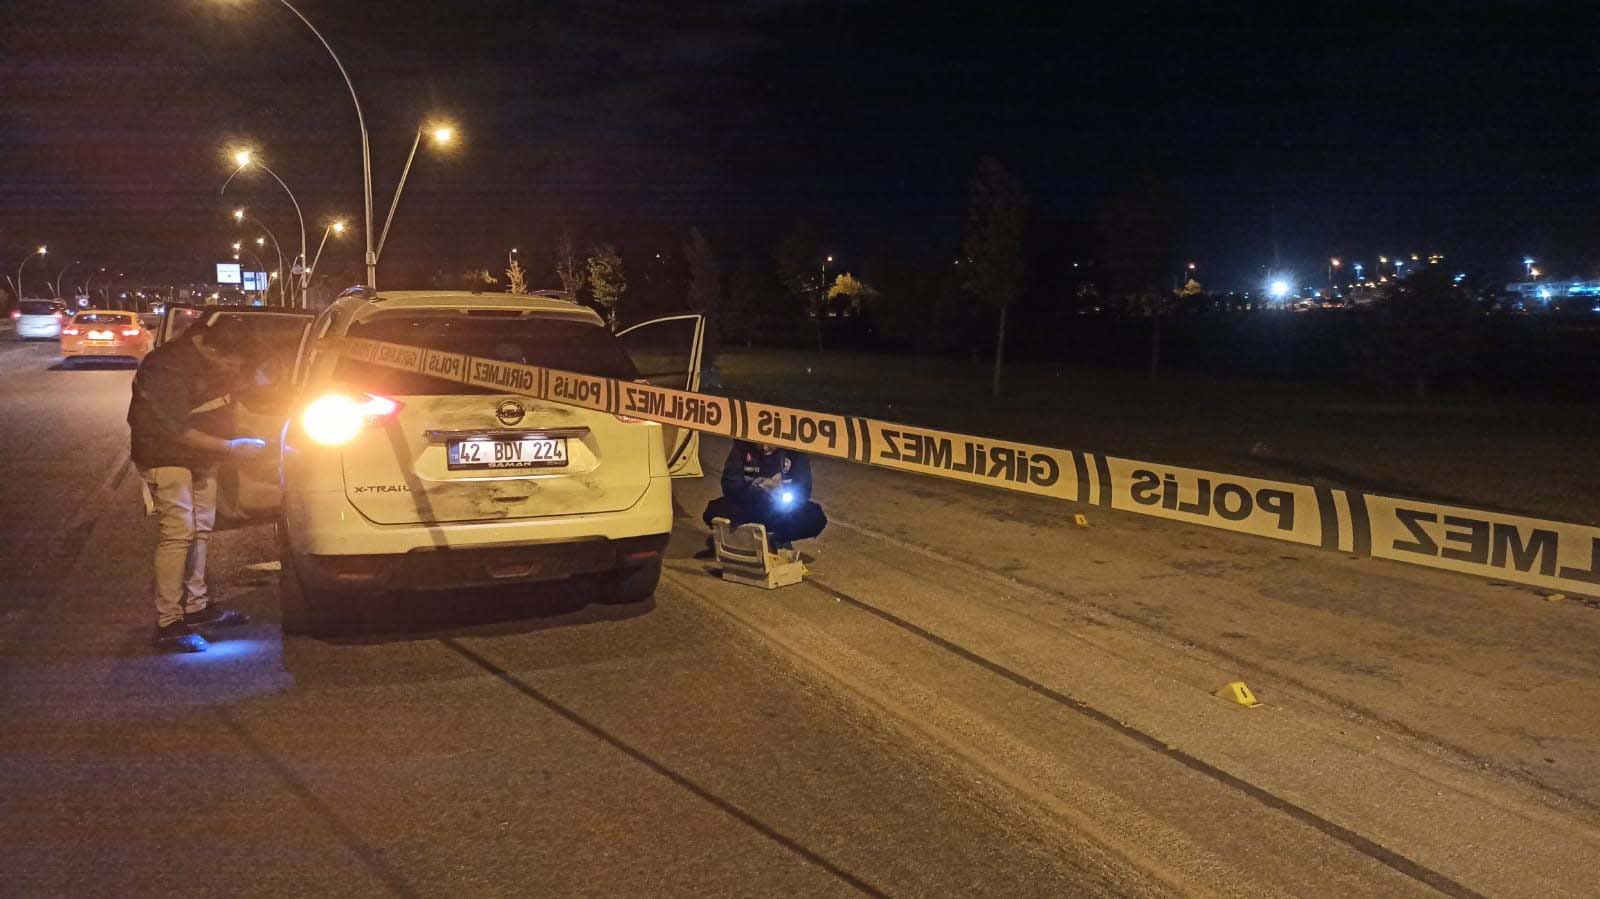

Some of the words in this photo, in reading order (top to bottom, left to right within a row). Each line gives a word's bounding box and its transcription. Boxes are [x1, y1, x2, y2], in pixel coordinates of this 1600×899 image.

[461, 443, 480, 461] 42
[494, 442, 522, 461] BDV
[533, 441, 562, 459] 224
